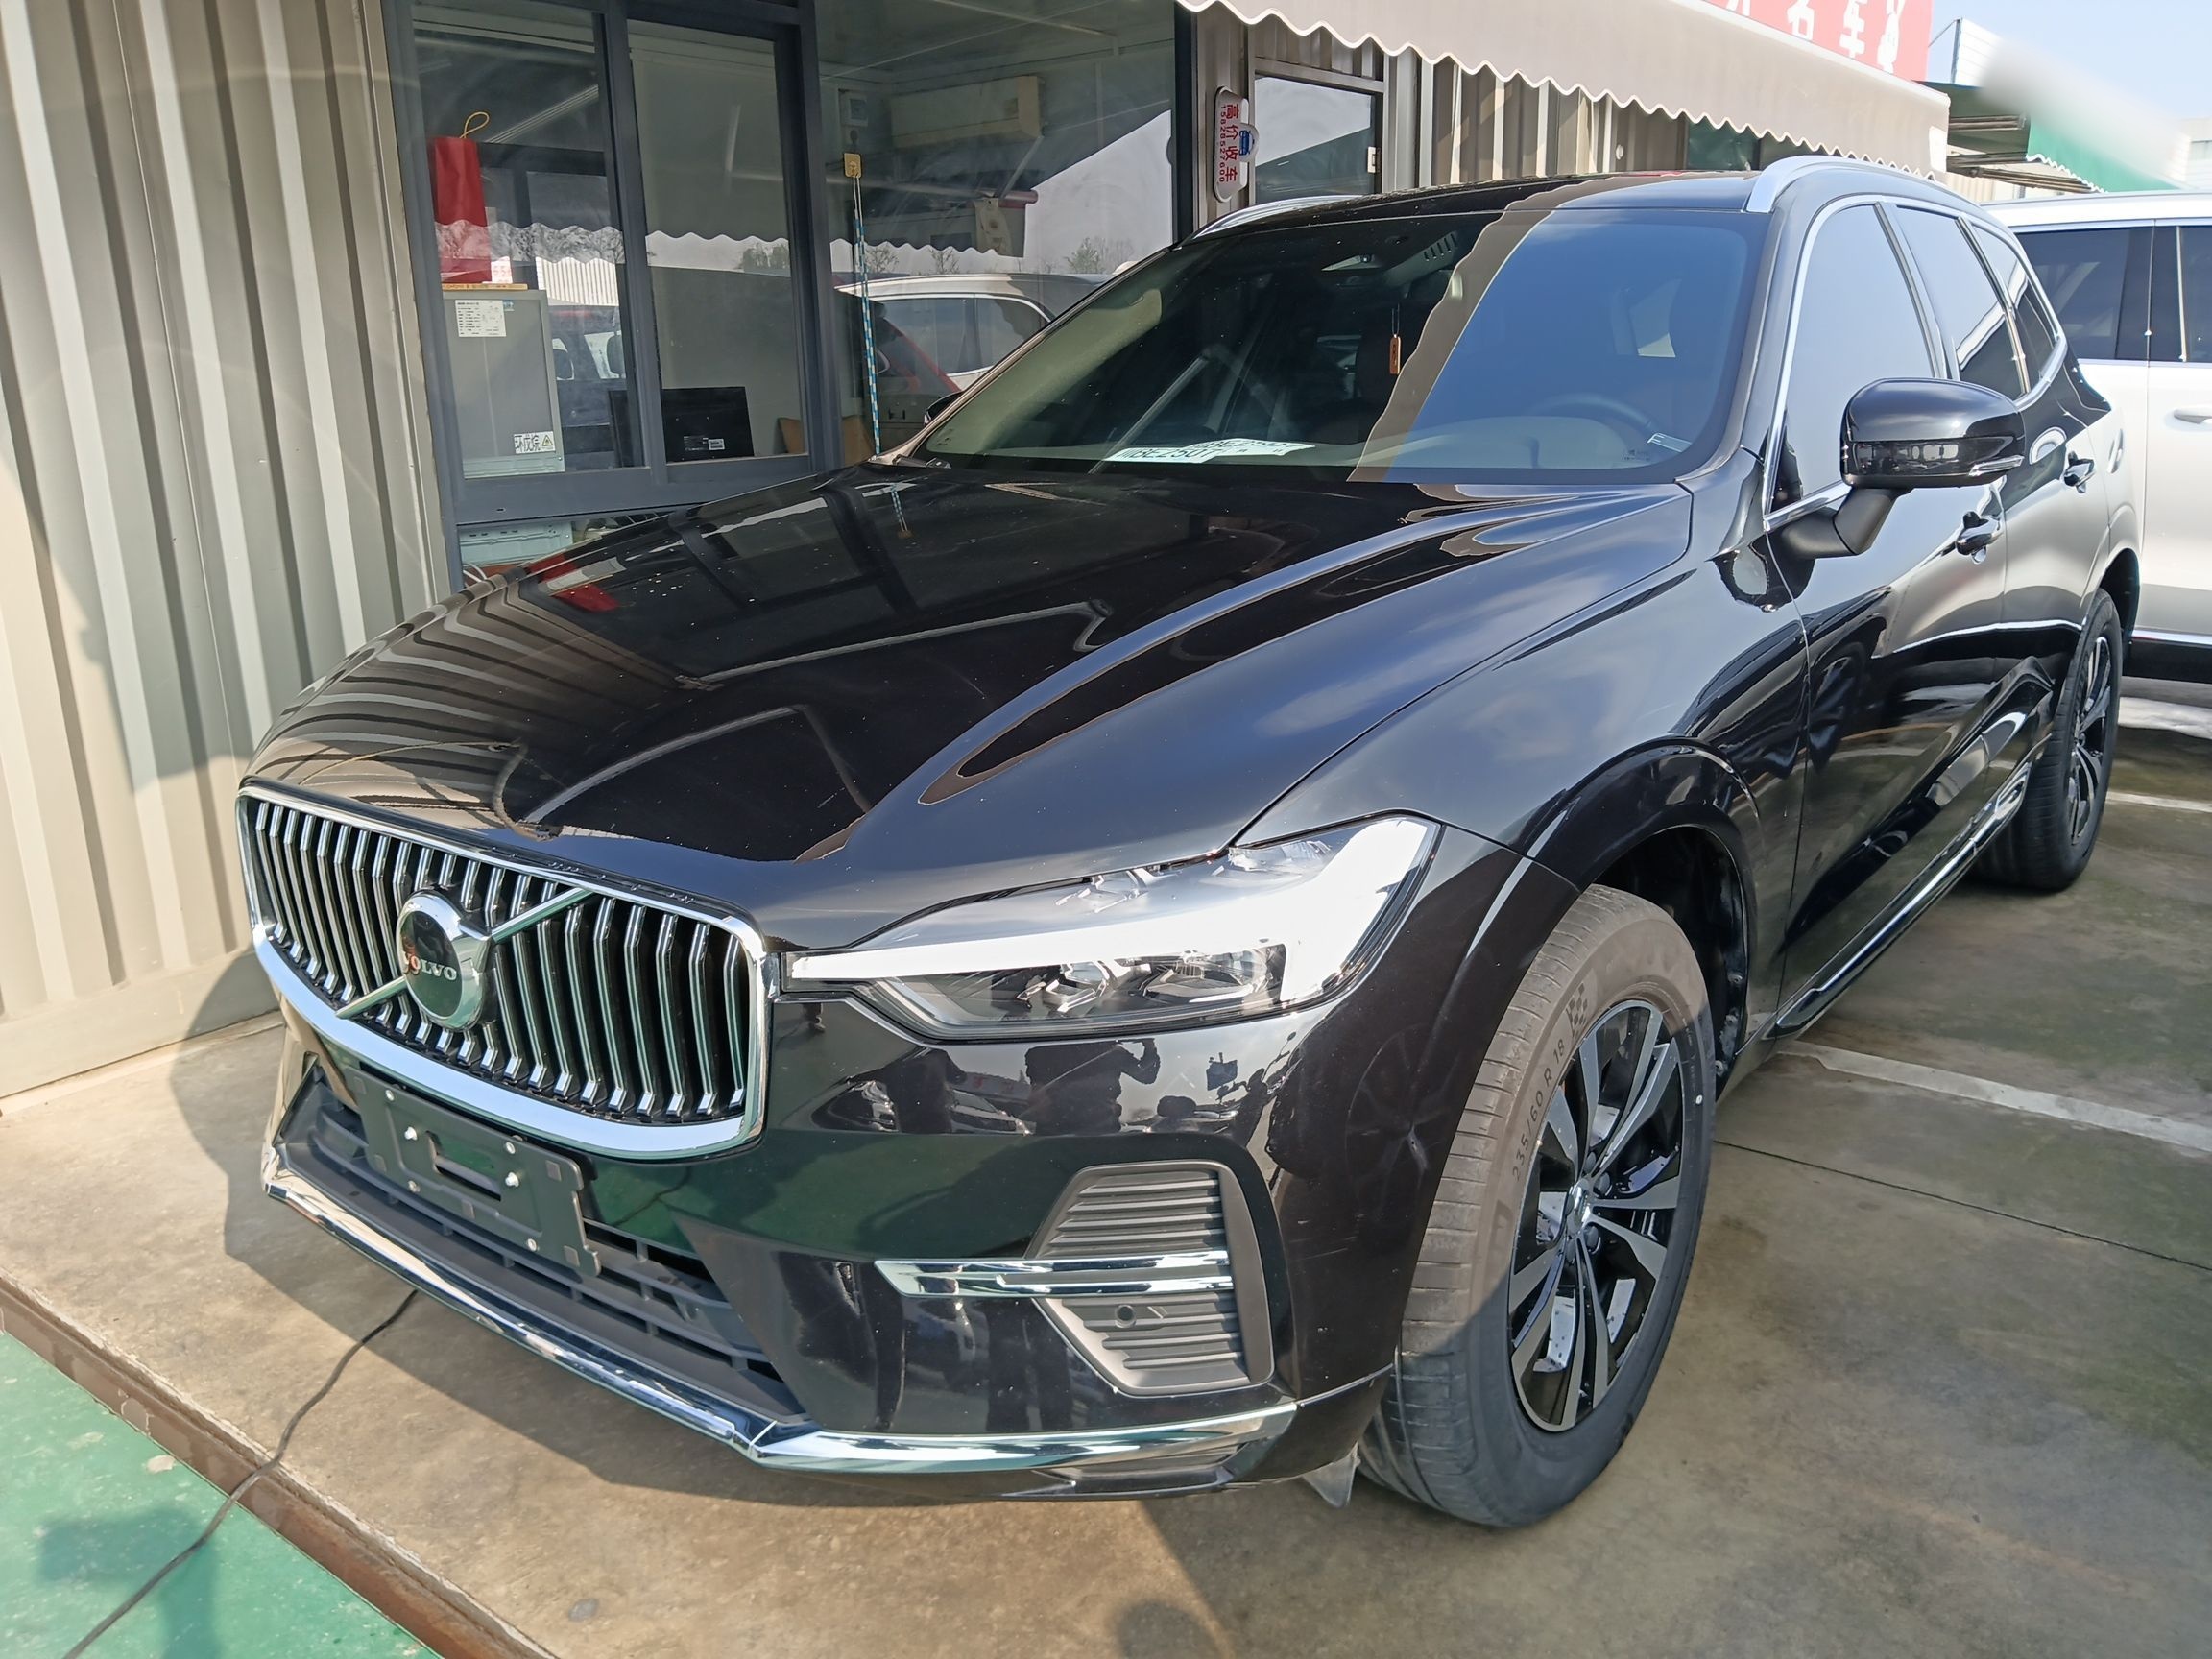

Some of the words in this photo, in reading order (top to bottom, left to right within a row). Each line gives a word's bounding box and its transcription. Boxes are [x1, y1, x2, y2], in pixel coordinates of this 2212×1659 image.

[1225, 104, 1239, 181] 高价收车
[1512, 1090, 1544, 1182] 235/60
[1544, 1067, 1553, 1087] R
[1553, 1039, 1565, 1064] 18
